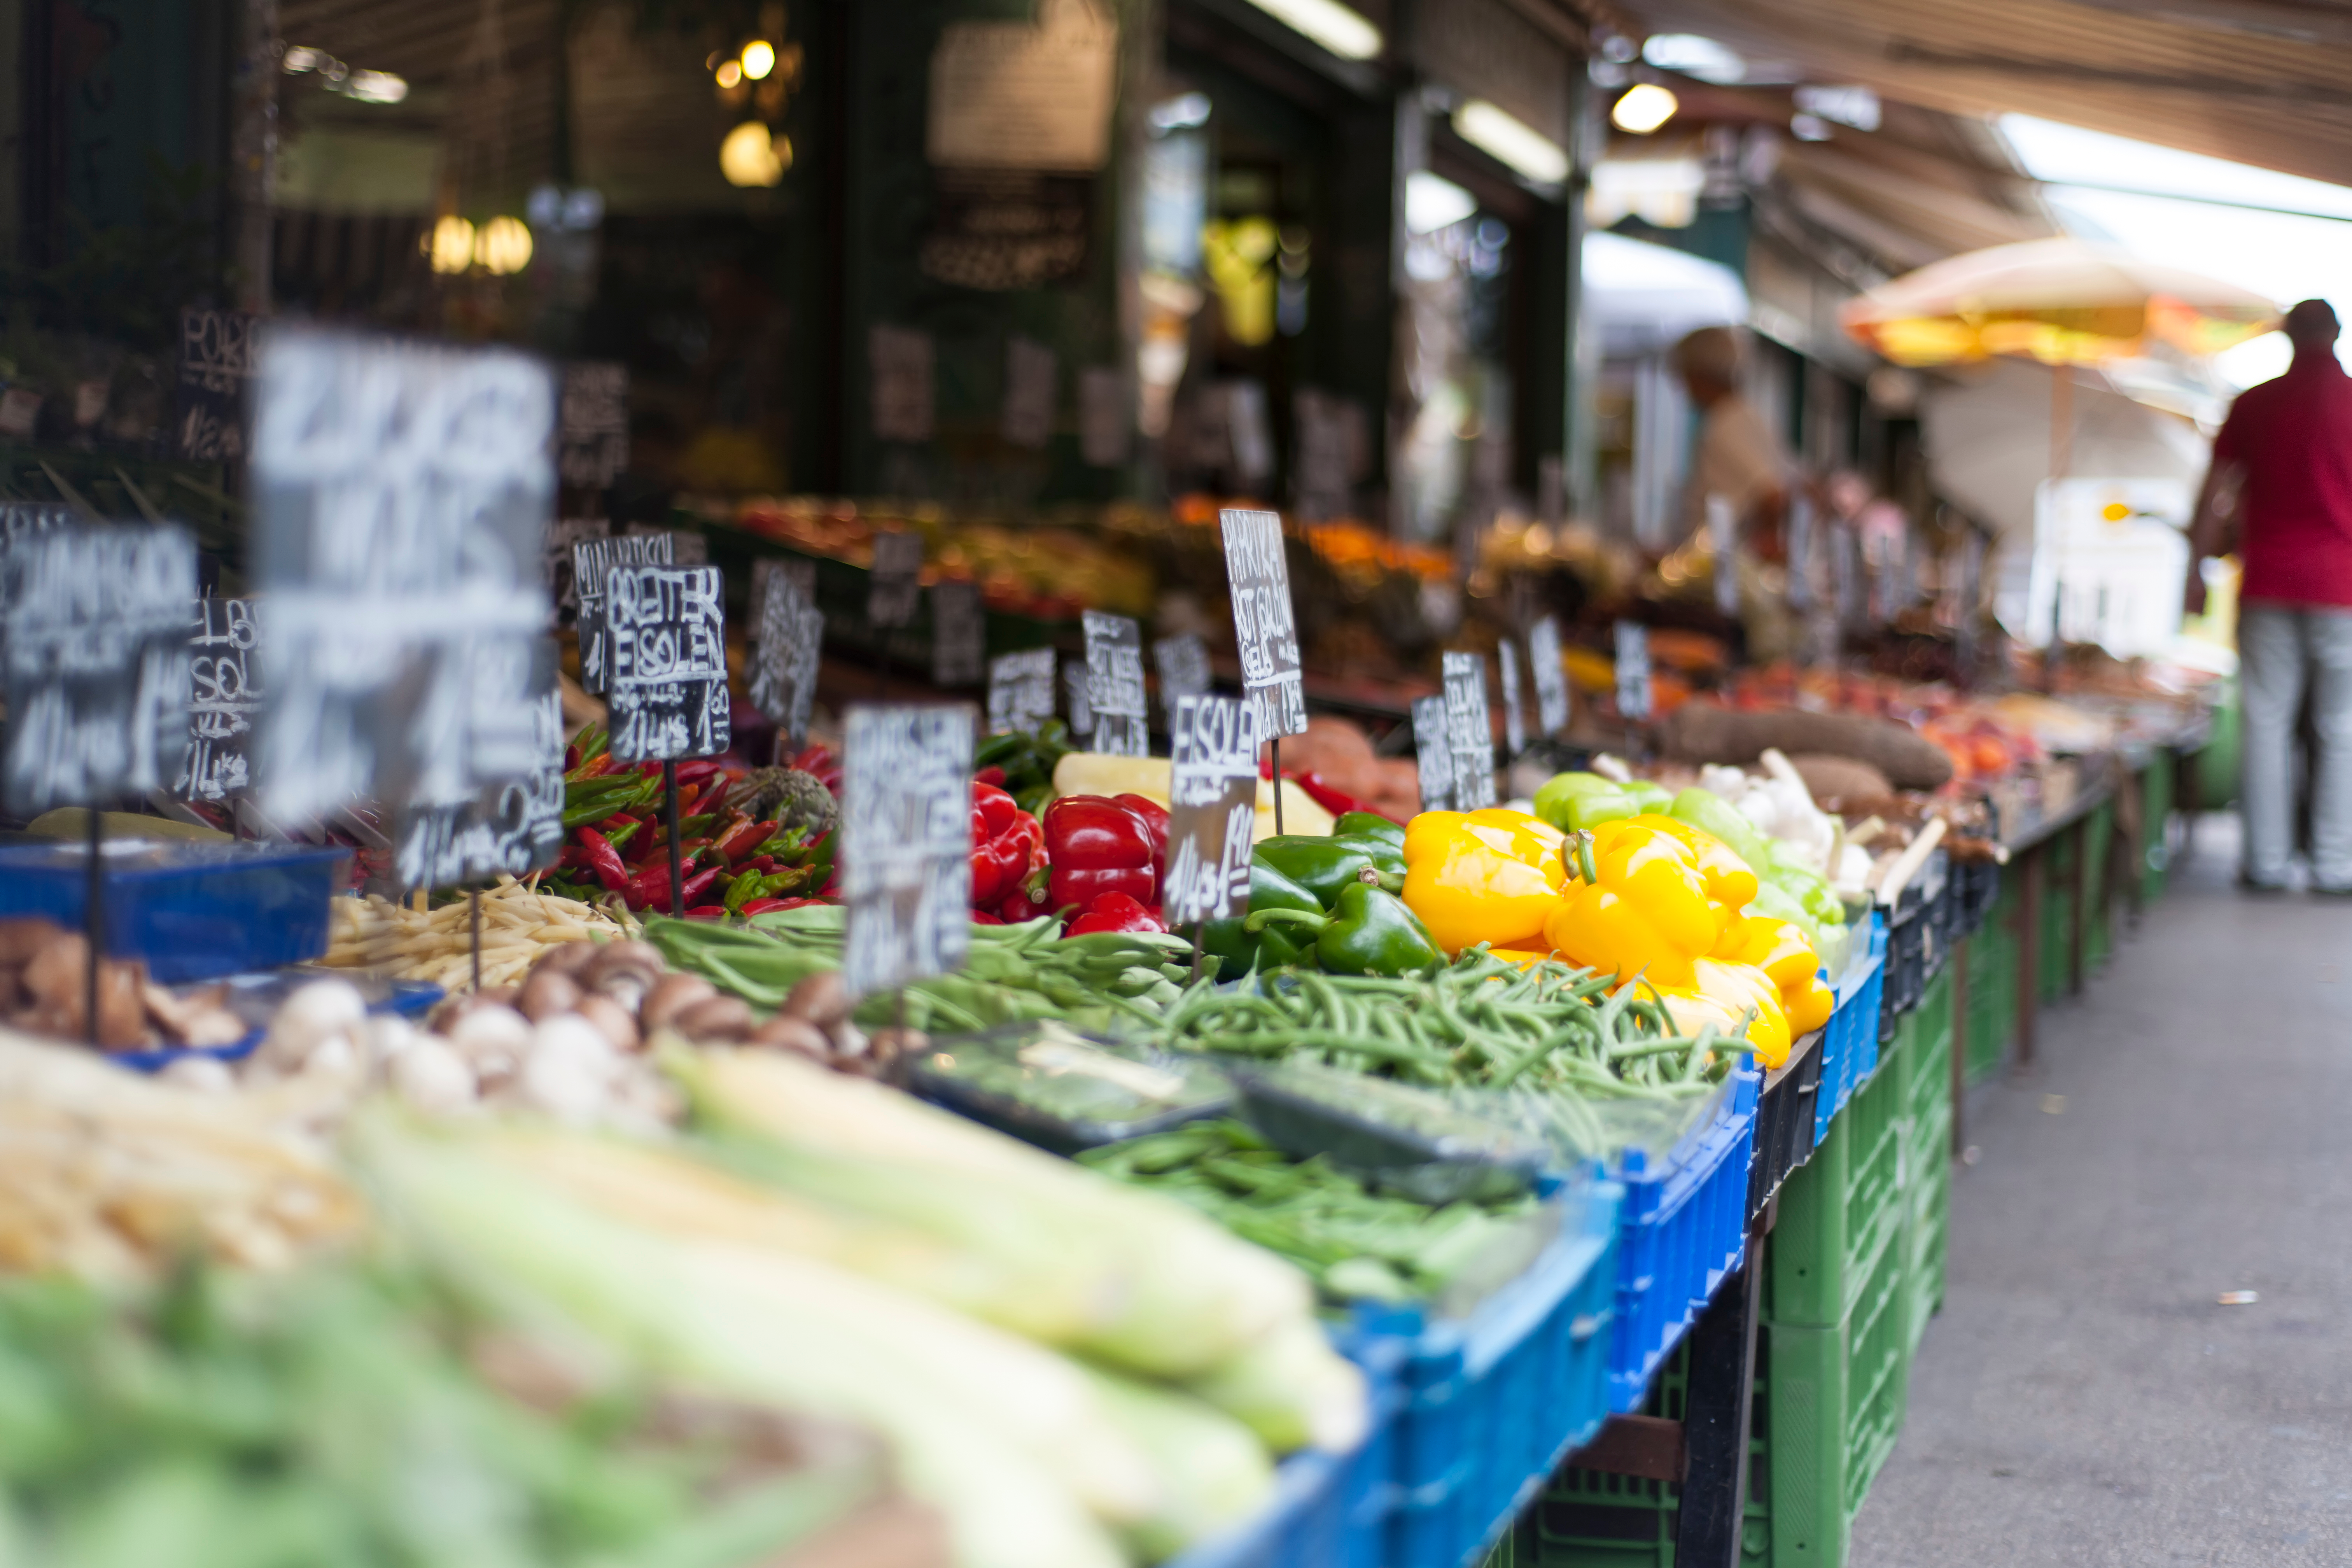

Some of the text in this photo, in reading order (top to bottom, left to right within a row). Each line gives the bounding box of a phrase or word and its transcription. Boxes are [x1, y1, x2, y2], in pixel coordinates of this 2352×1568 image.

[1222, 511, 1281, 583] PAPRIKA
[1233, 583, 1256, 644] ROT
[615, 623, 725, 677] FISOLEN
[1241, 641, 1274, 680] GELB
[1172, 695, 1260, 766] FISOLEN
